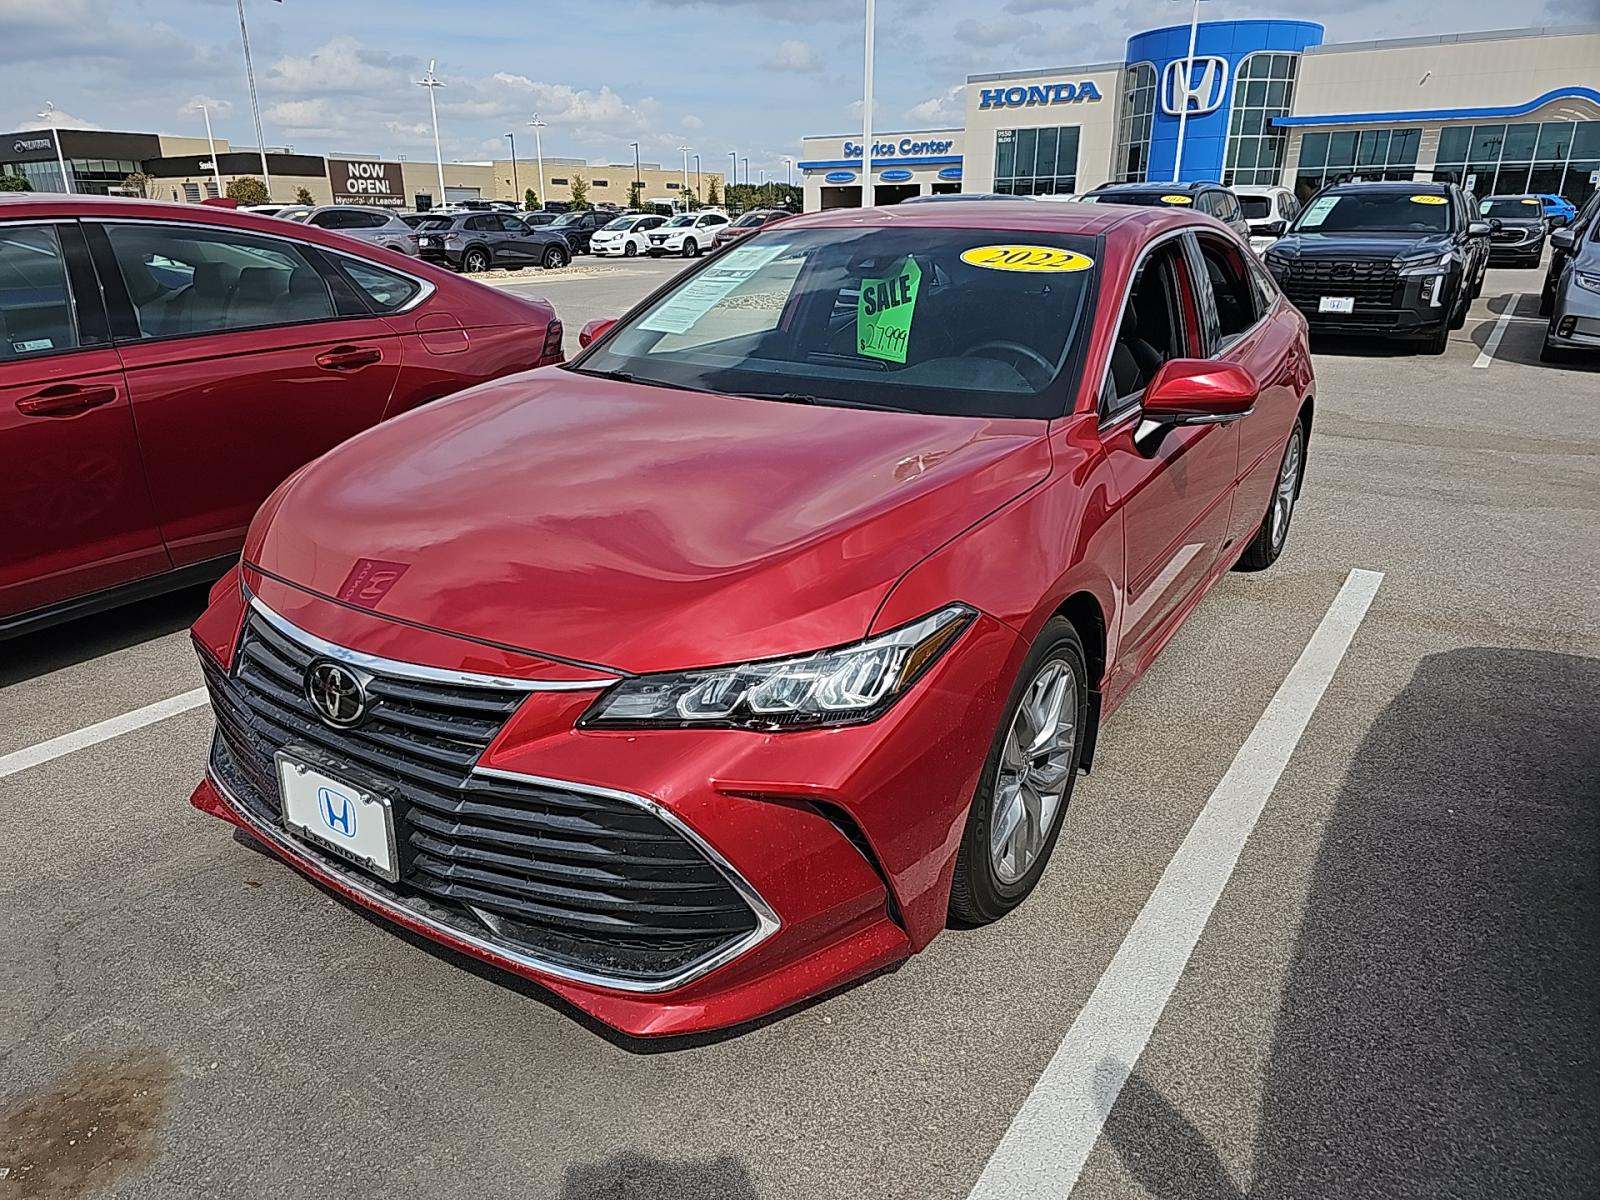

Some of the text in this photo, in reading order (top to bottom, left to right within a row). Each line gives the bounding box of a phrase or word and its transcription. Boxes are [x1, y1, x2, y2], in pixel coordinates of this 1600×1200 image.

[979, 82, 1102, 109] HONDA
[899, 138, 953, 156] Center
[348, 163, 384, 178] NOW
[346, 179, 391, 193] OPEN!
[375, 197, 403, 205] Leander
[981, 250, 1074, 267] 2022
[863, 274, 912, 316] SALE
[303, 826, 376, 872] LEANDER
